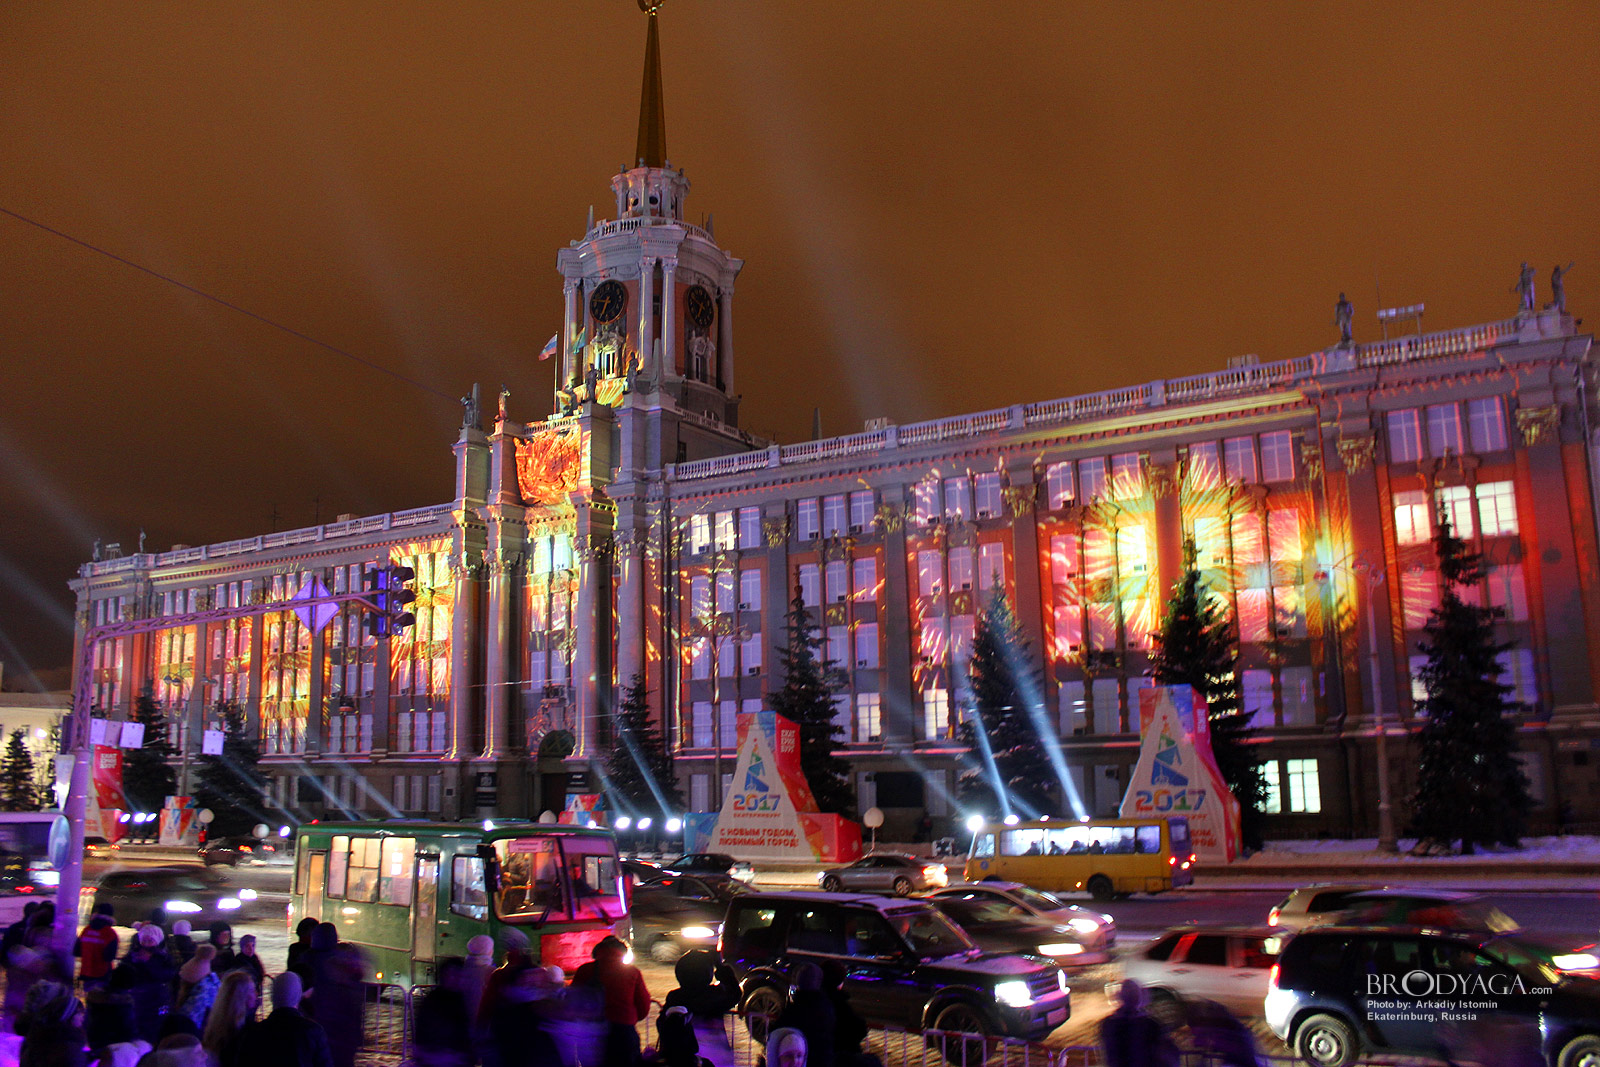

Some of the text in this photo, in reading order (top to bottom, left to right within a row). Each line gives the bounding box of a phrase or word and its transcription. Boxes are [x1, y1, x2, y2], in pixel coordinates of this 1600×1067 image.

[733, 793, 781, 811] 2017
[1135, 789, 1207, 812] 2017
[720, 828, 725, 836] С
[727, 828, 760, 836] НОВЫМ
[719, 835, 765, 846] ЛЮБИМЫЙ
